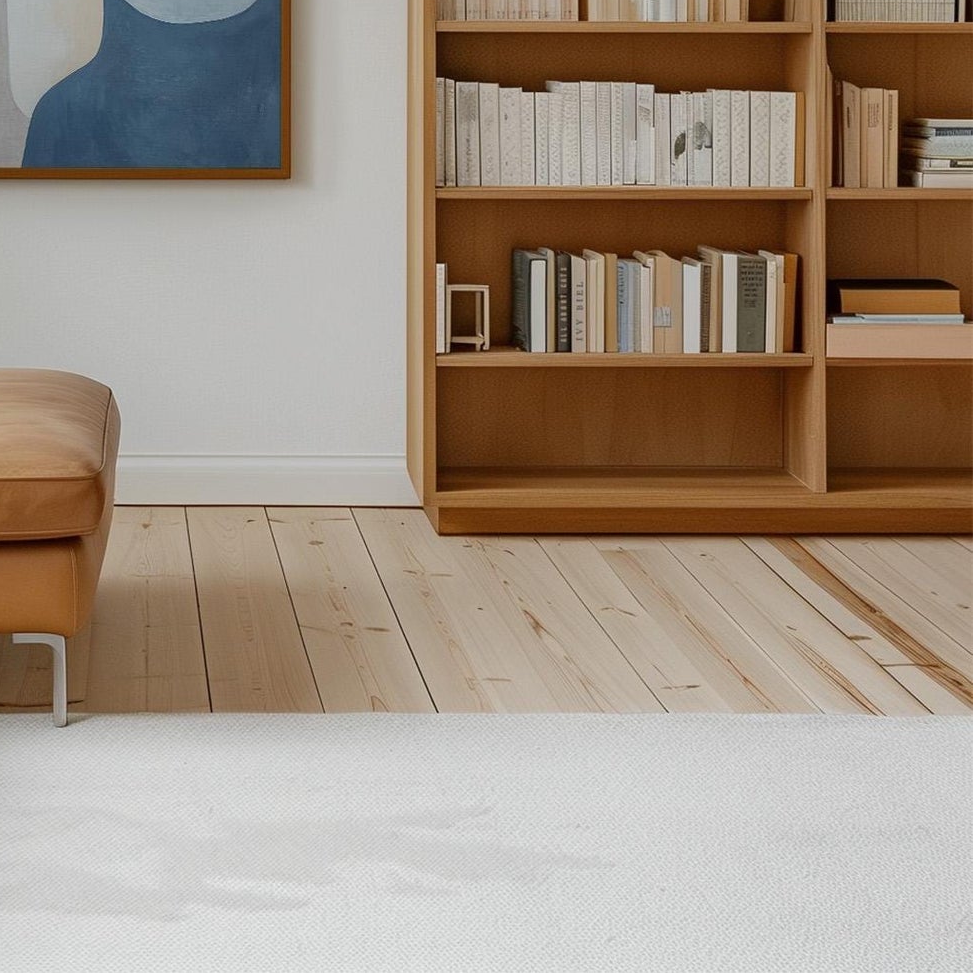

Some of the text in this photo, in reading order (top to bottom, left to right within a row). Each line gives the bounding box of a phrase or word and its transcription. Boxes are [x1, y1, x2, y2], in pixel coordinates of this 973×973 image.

[560, 267, 568, 343] ALL ABOUT CATS
[576, 281, 584, 342] IVY BIEL
